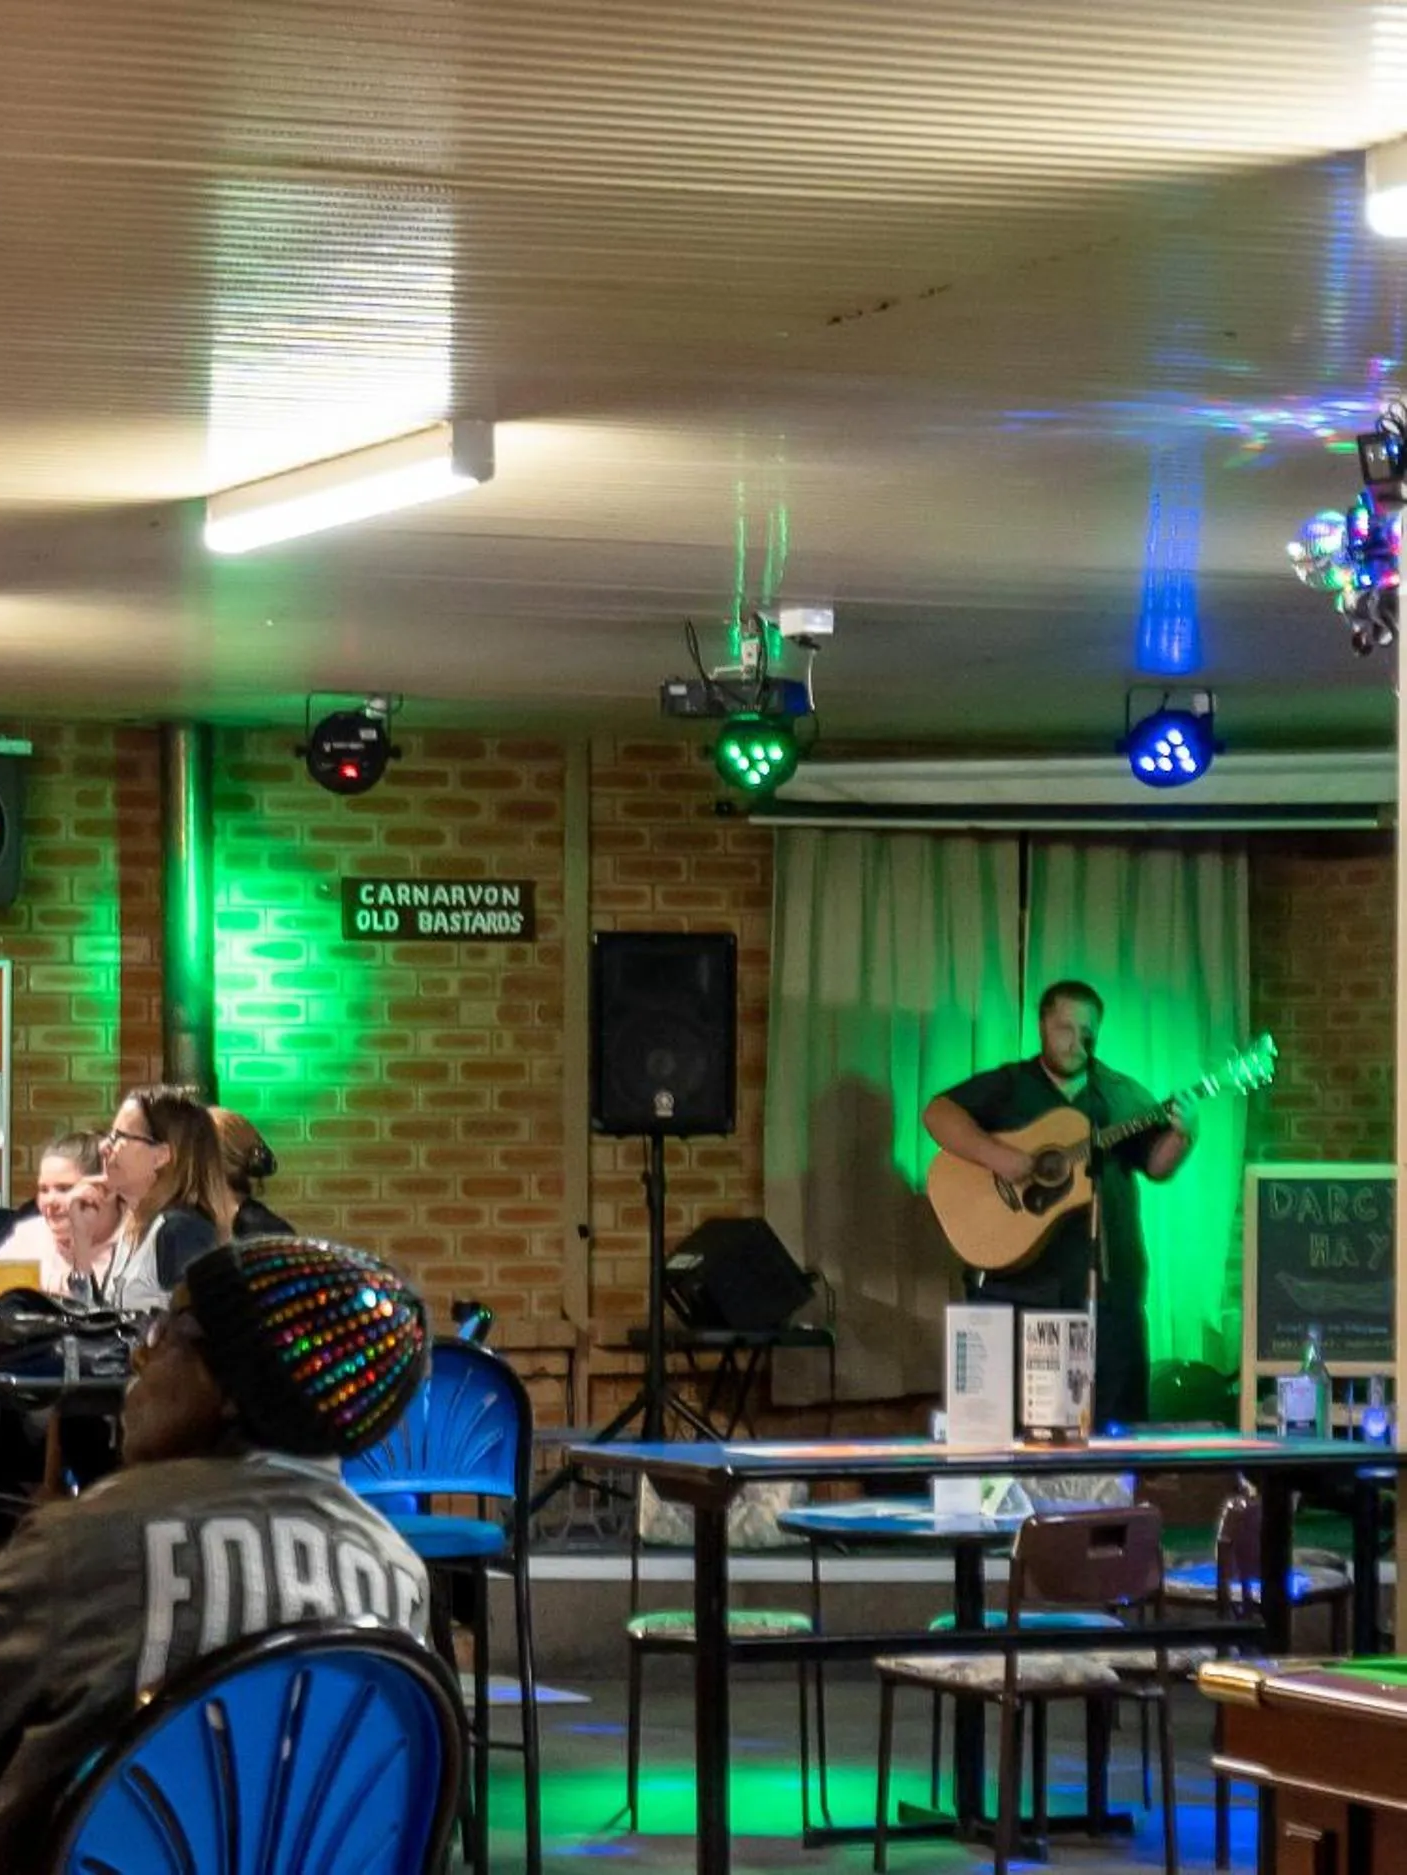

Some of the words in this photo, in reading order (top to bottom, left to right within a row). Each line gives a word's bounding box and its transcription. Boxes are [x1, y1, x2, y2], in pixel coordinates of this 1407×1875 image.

[360, 883, 520, 907] CARNARVON
[356, 910, 400, 932] OLD
[418, 910, 525, 934] BASTARDS
